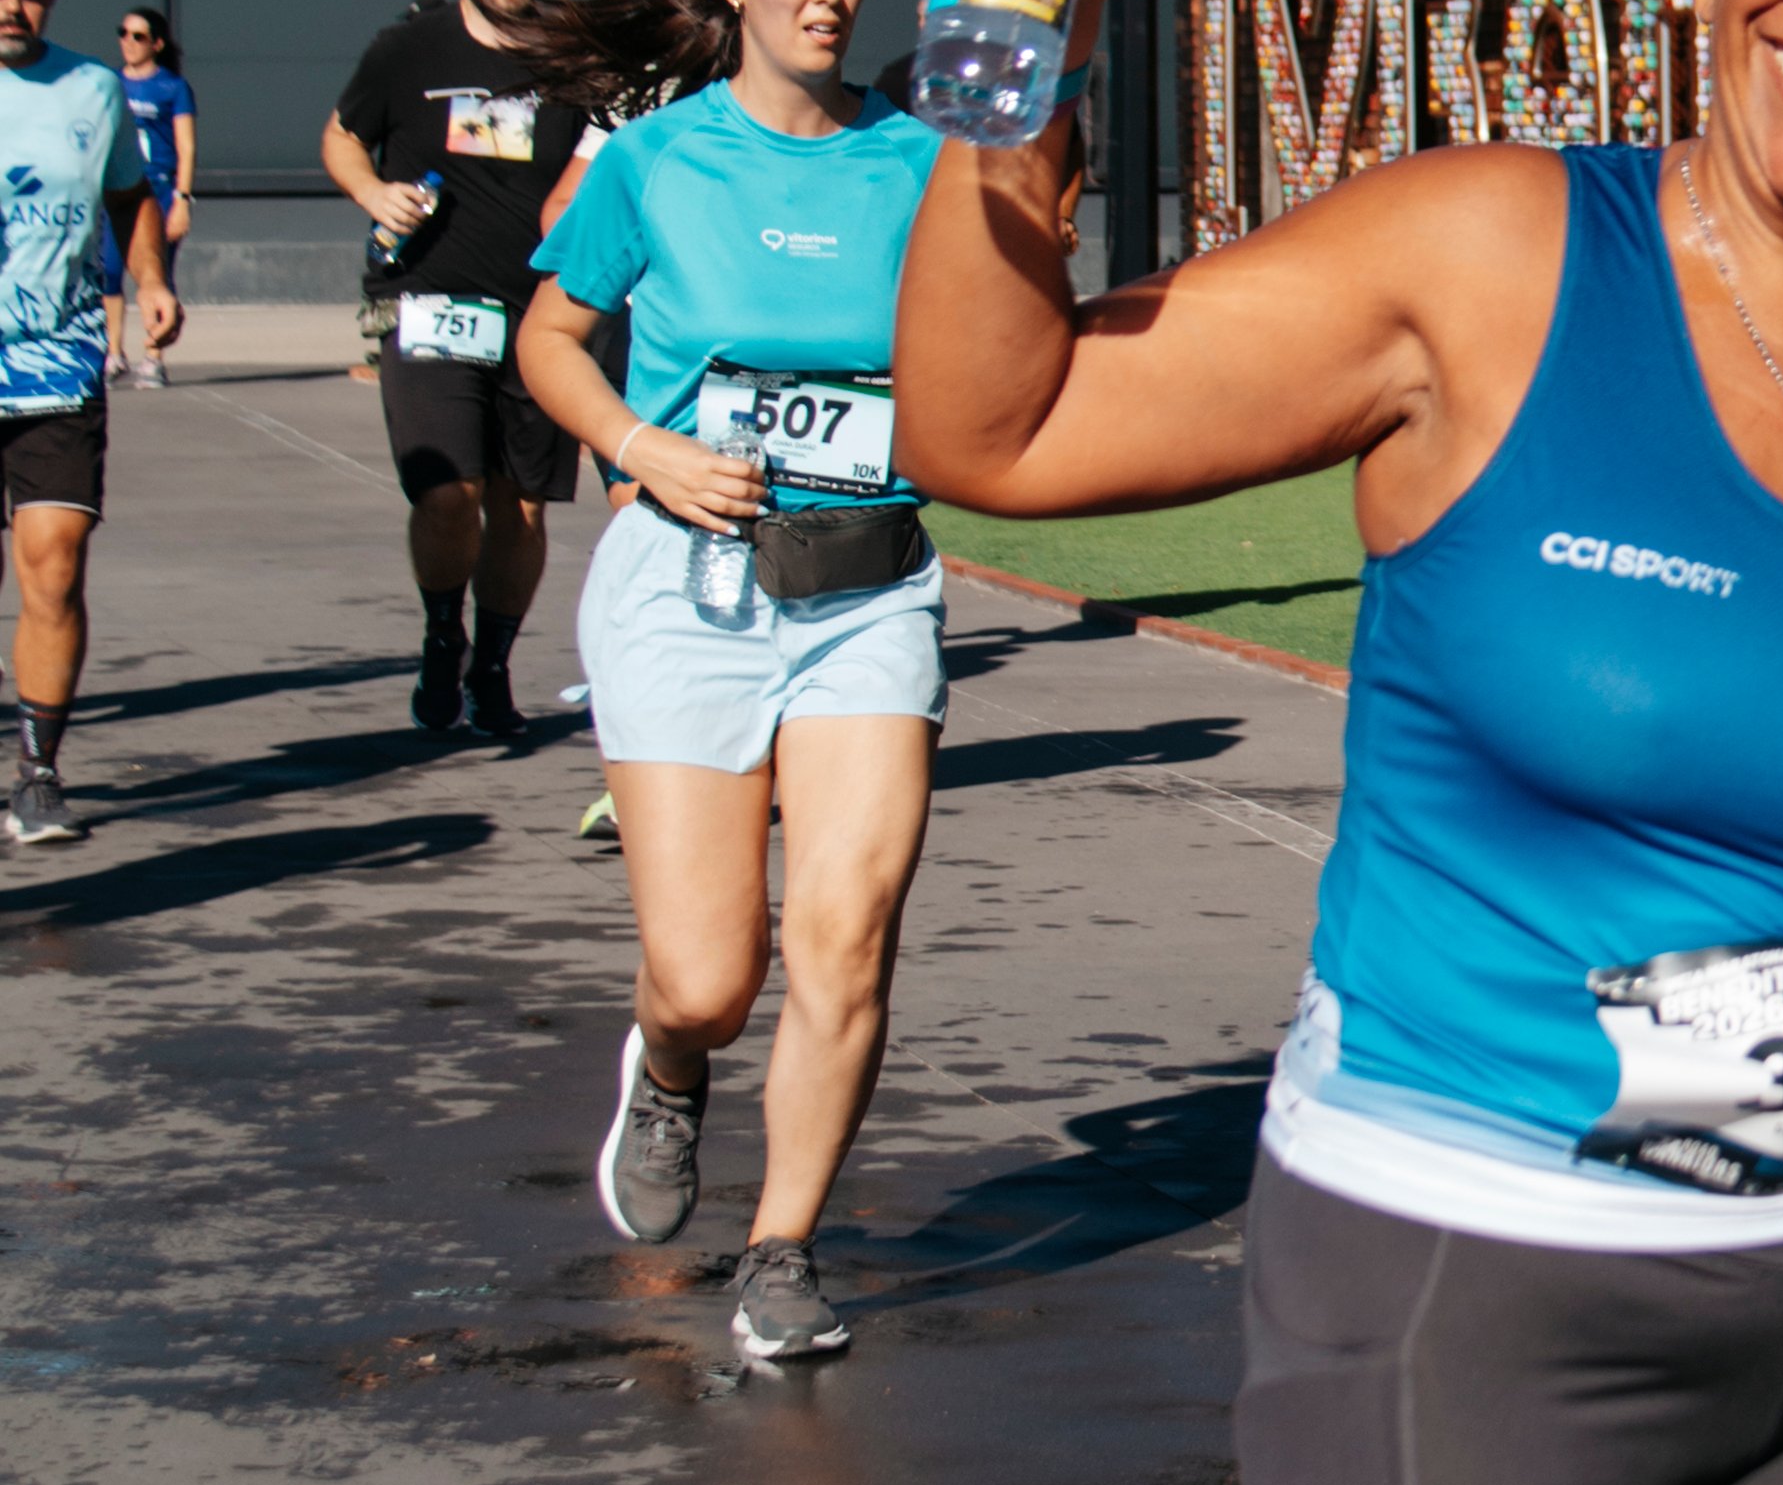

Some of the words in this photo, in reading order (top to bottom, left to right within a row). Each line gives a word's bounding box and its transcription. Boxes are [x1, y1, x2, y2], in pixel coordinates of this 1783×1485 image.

[433, 313, 478, 339] 751
[752, 390, 853, 445] 507
[852, 463, 883, 480] 10K
[1540, 531, 1610, 572] CCI
[1610, 544, 1742, 599] SPORT
